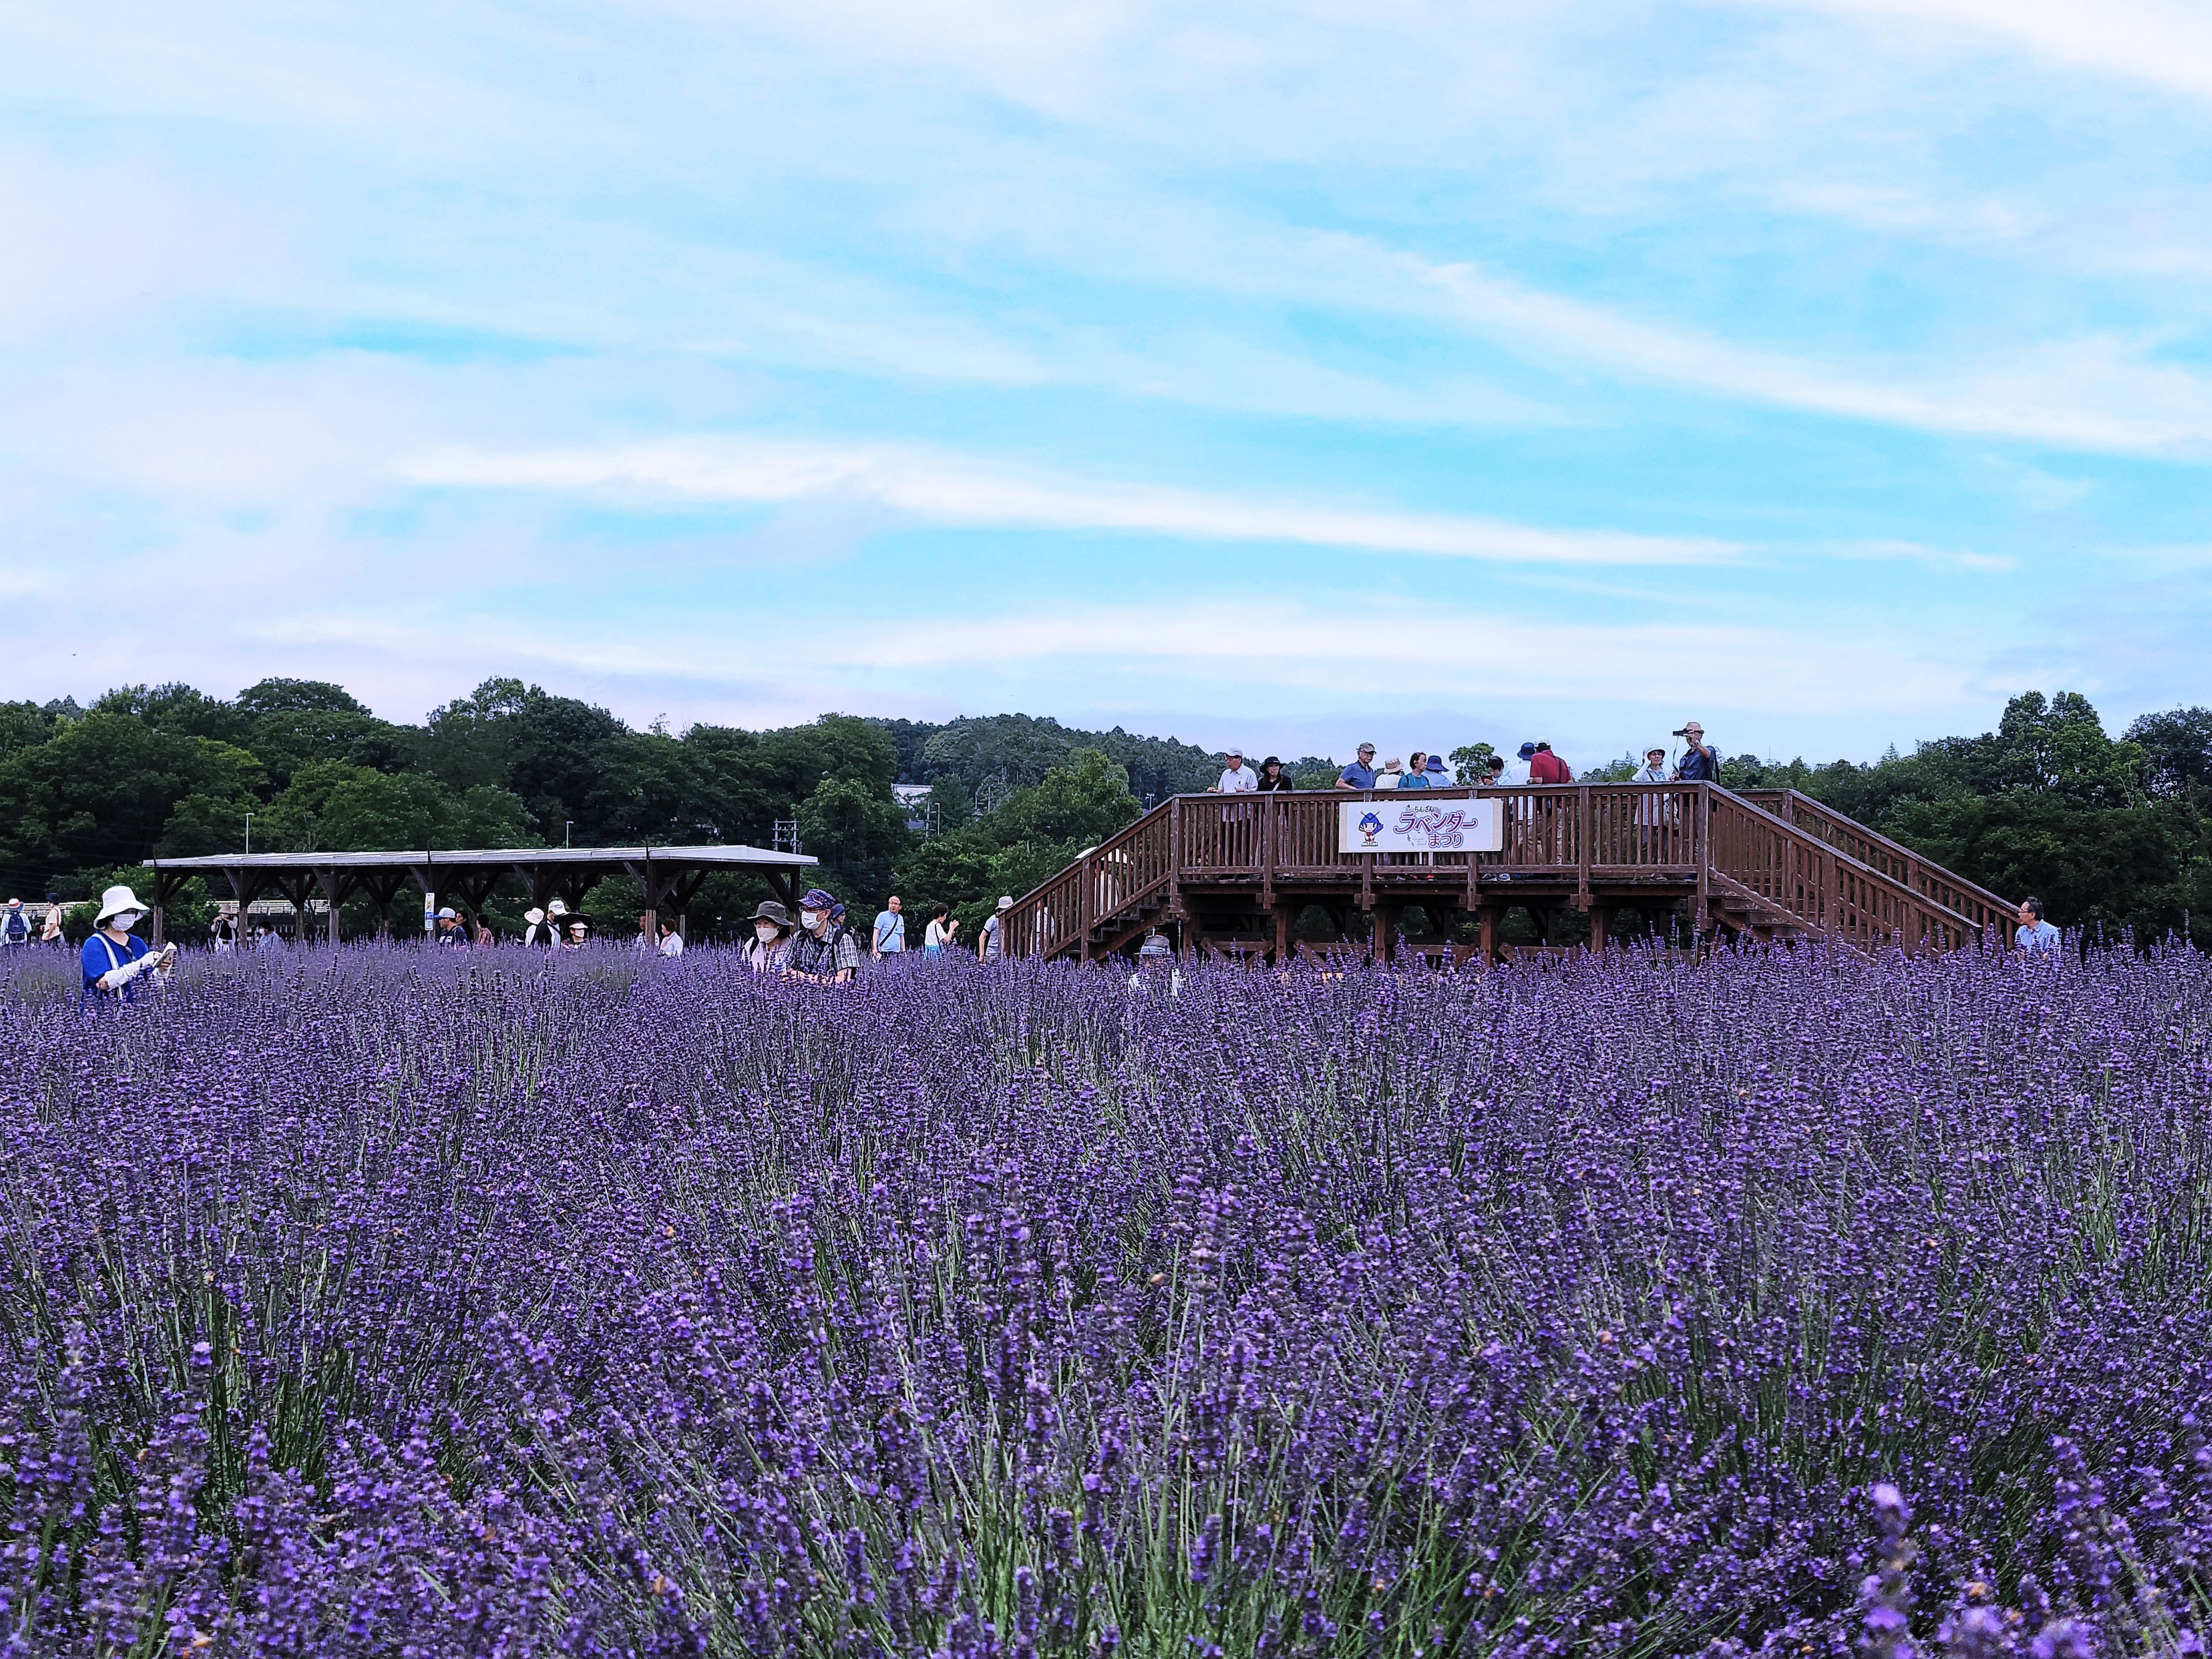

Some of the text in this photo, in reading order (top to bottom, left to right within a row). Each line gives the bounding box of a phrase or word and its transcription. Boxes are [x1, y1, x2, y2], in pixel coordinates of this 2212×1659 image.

[1394, 811, 1478, 833] ラベンダー
[1429, 833, 1463, 847] まつり
